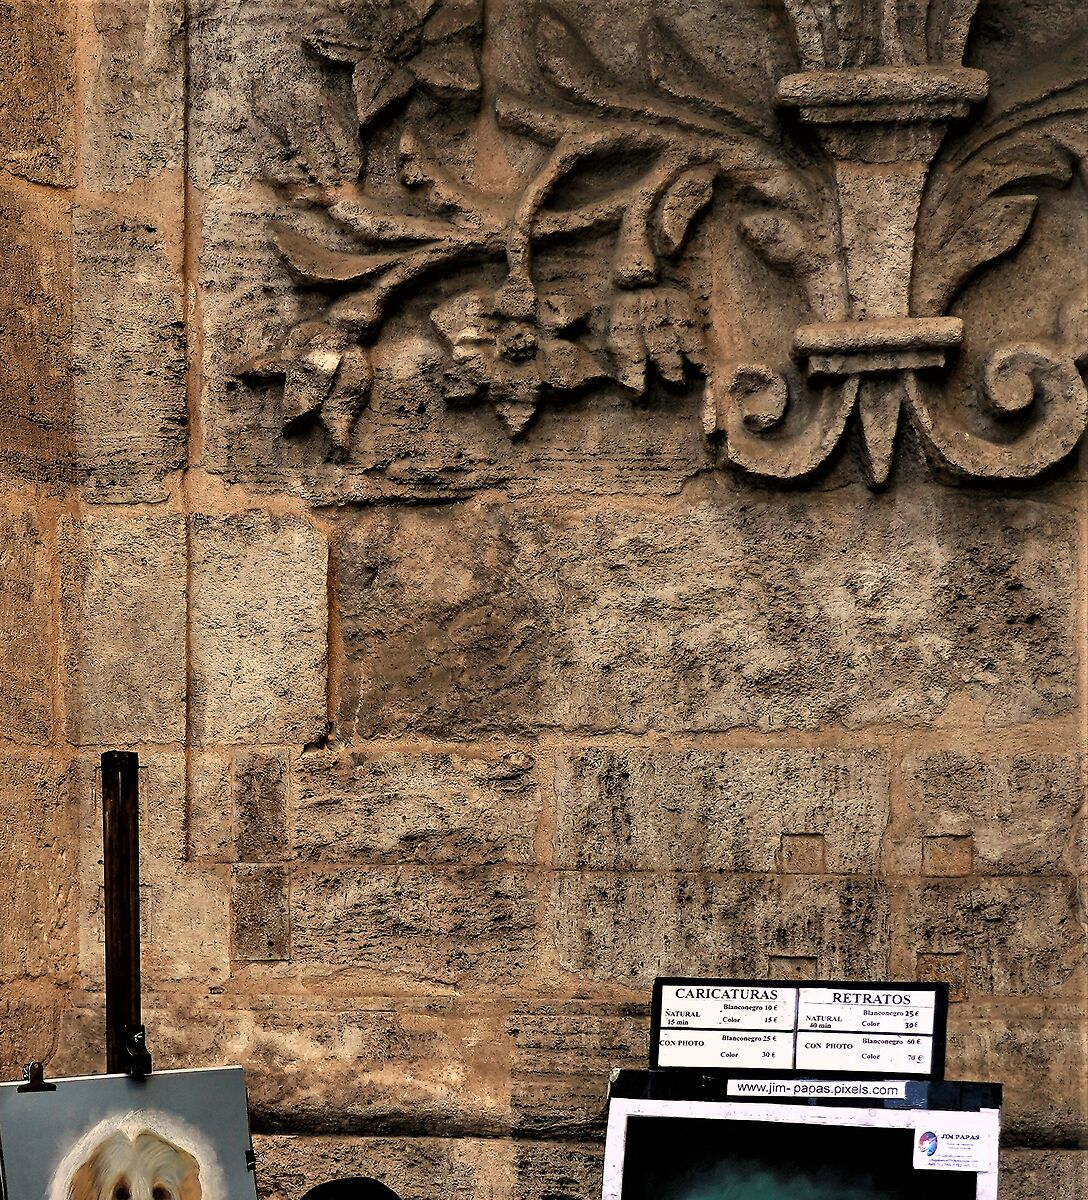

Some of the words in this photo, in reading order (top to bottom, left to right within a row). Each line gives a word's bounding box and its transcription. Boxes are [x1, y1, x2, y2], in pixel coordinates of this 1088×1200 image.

[675, 988, 778, 1000] CARICATURAS
[832, 992, 911, 1005] RETRATOS
[723, 1003, 763, 1012] Blanconegro
[665, 1010, 701, 1018] NATURAL
[863, 1009, 904, 1017] Blanconegro
[659, 1039, 675, 1047] CON
[721, 1034, 762, 1043] Blanconegro
[862, 1037, 903, 1046] Blanconegro
[804, 1042, 822, 1050] CON
[793, 1083, 898, 1096] papas.pixels.com
